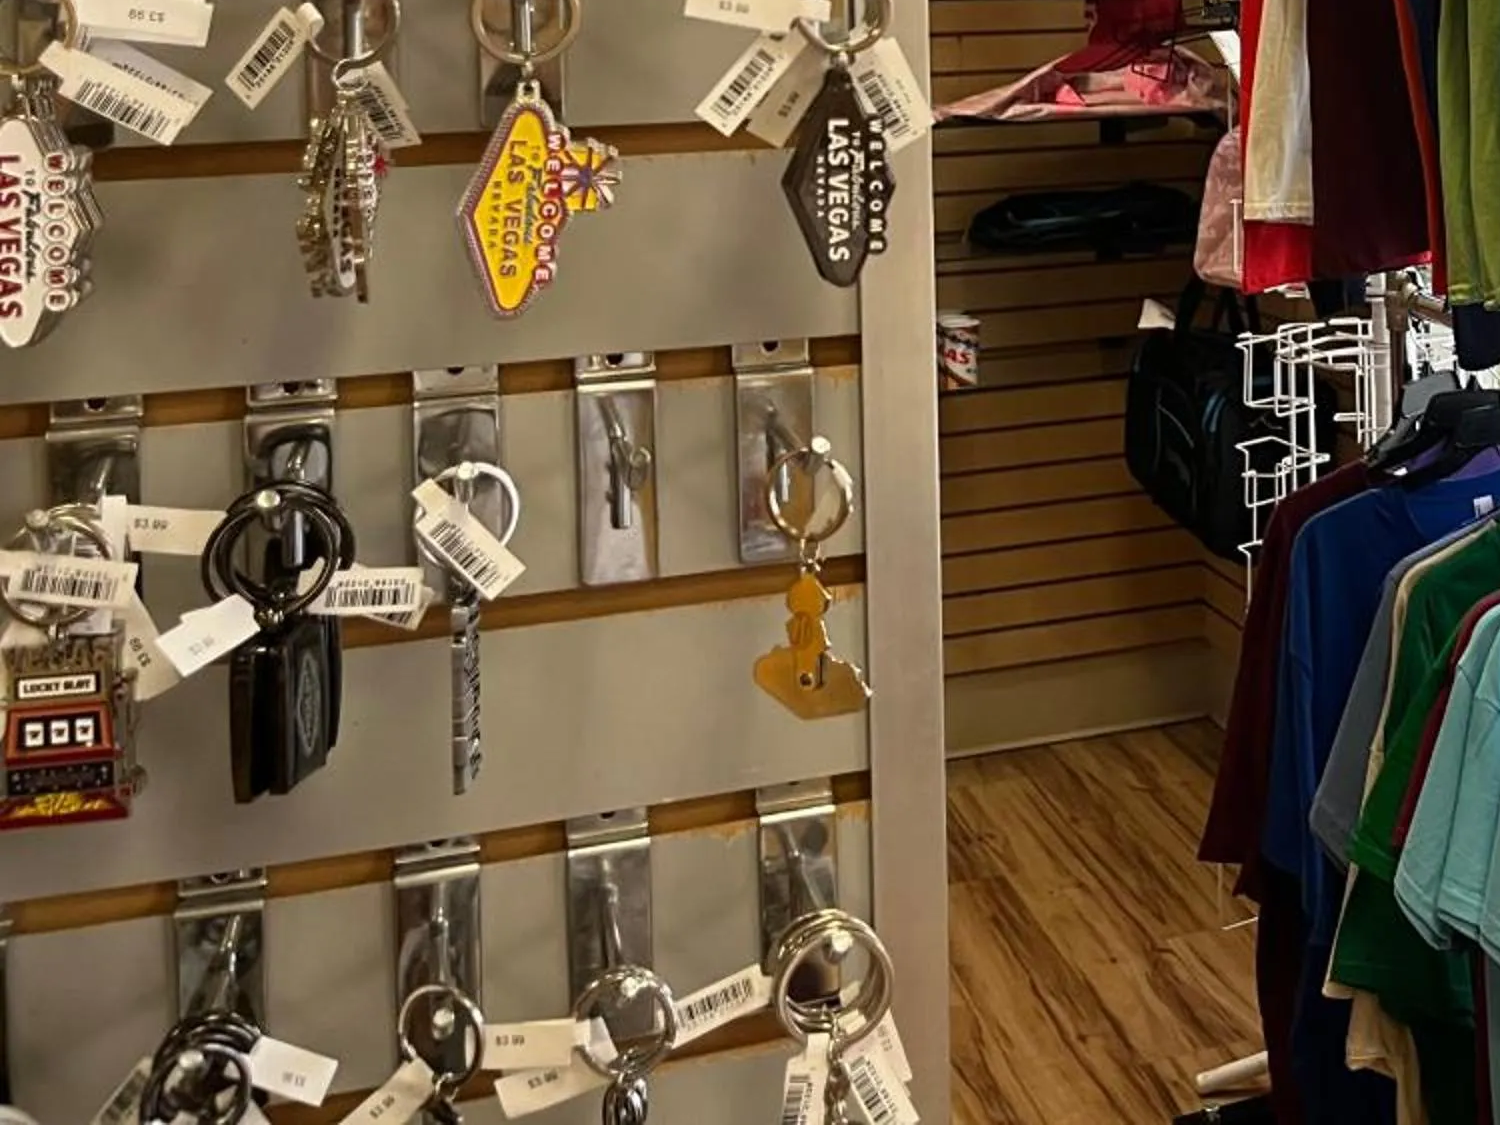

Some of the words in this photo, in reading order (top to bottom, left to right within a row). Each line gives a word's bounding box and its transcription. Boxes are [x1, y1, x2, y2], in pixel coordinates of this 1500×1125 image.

[508, 140, 528, 182] LAS
[827, 118, 850, 166] LAS
[534, 133, 562, 283] WELCOME
[816, 155, 826, 218] NEVADA
[828, 173, 850, 262] VEGAS
[868, 119, 884, 251] WELCOME
[46, 152, 66, 307] WELCOME
[499, 199, 523, 278] VEGAS
